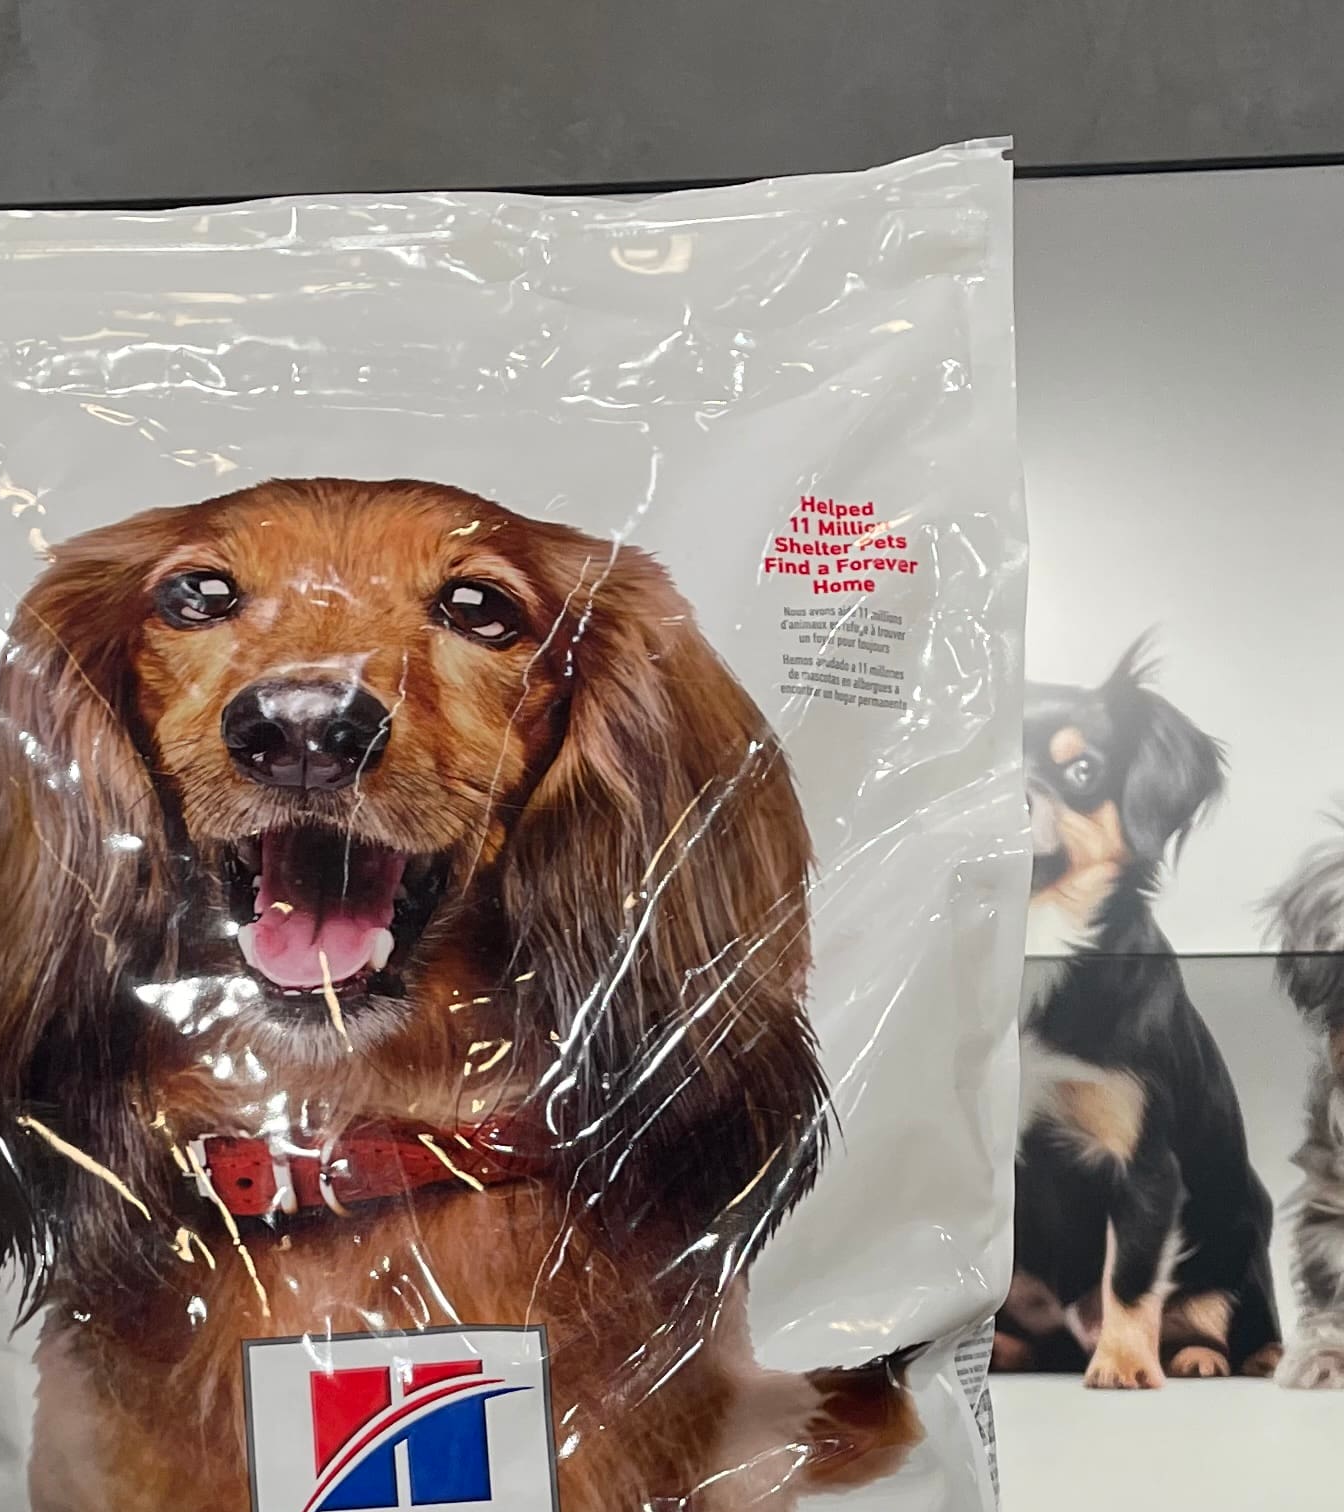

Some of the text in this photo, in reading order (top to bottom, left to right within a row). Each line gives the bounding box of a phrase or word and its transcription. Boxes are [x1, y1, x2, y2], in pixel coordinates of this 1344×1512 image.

[800, 495, 874, 519] Helped
[789, 516, 887, 537] 11 Millio
[774, 537, 853, 556] Shelter
[764, 557, 918, 576] Find a Forever
[813, 579, 875, 594] Home
